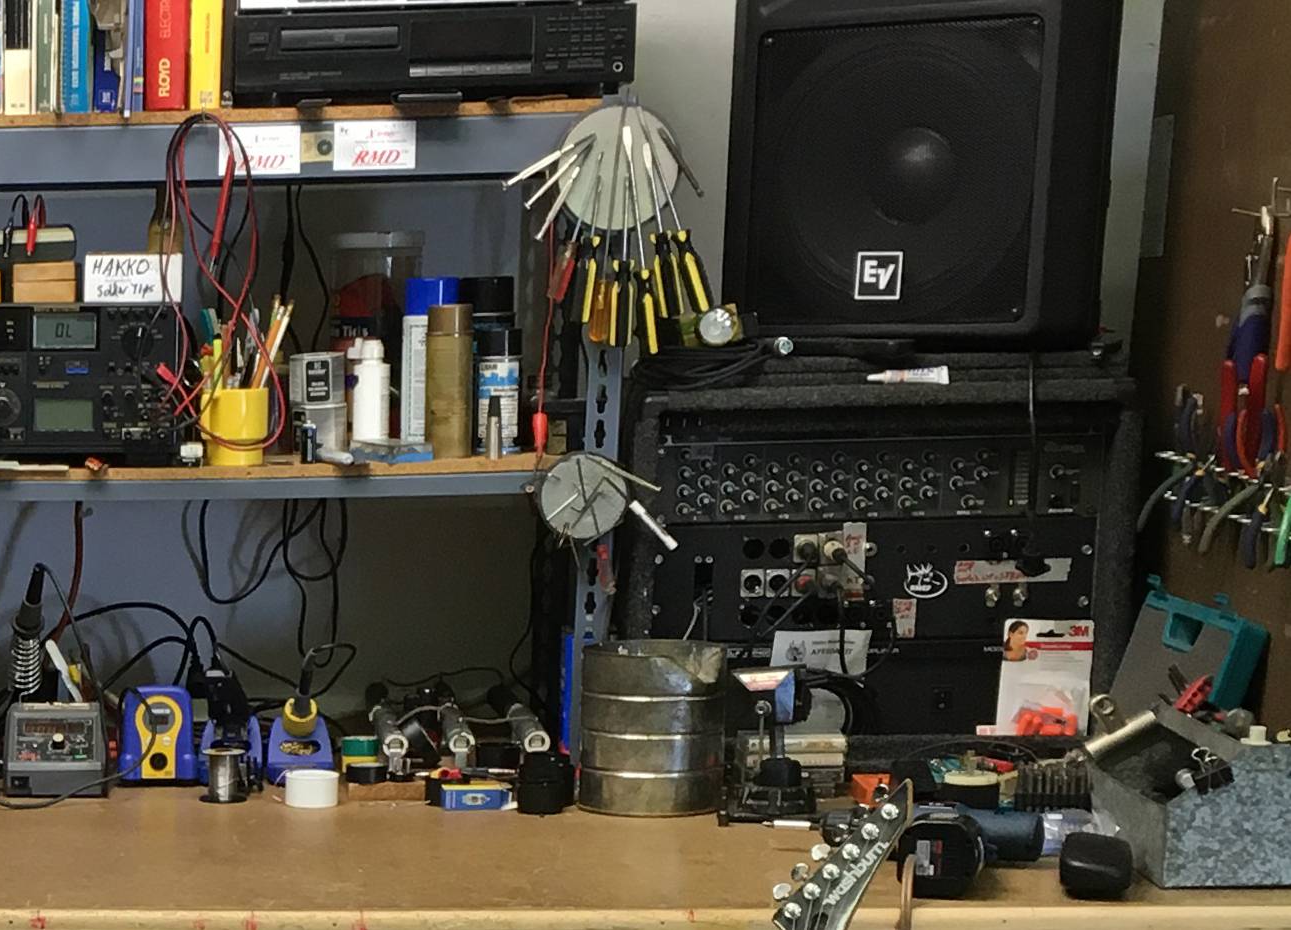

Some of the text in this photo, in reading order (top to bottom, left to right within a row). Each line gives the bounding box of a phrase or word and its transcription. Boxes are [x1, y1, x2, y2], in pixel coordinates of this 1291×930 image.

[158, 58, 170, 97] FLOYD
[352, 150, 401, 166] RMD
[92, 258, 149, 276] HAKKO
[863, 260, 895, 290] EV
[1068, 625, 1089, 637] 3M
[821, 841, 891, 906] washburn
